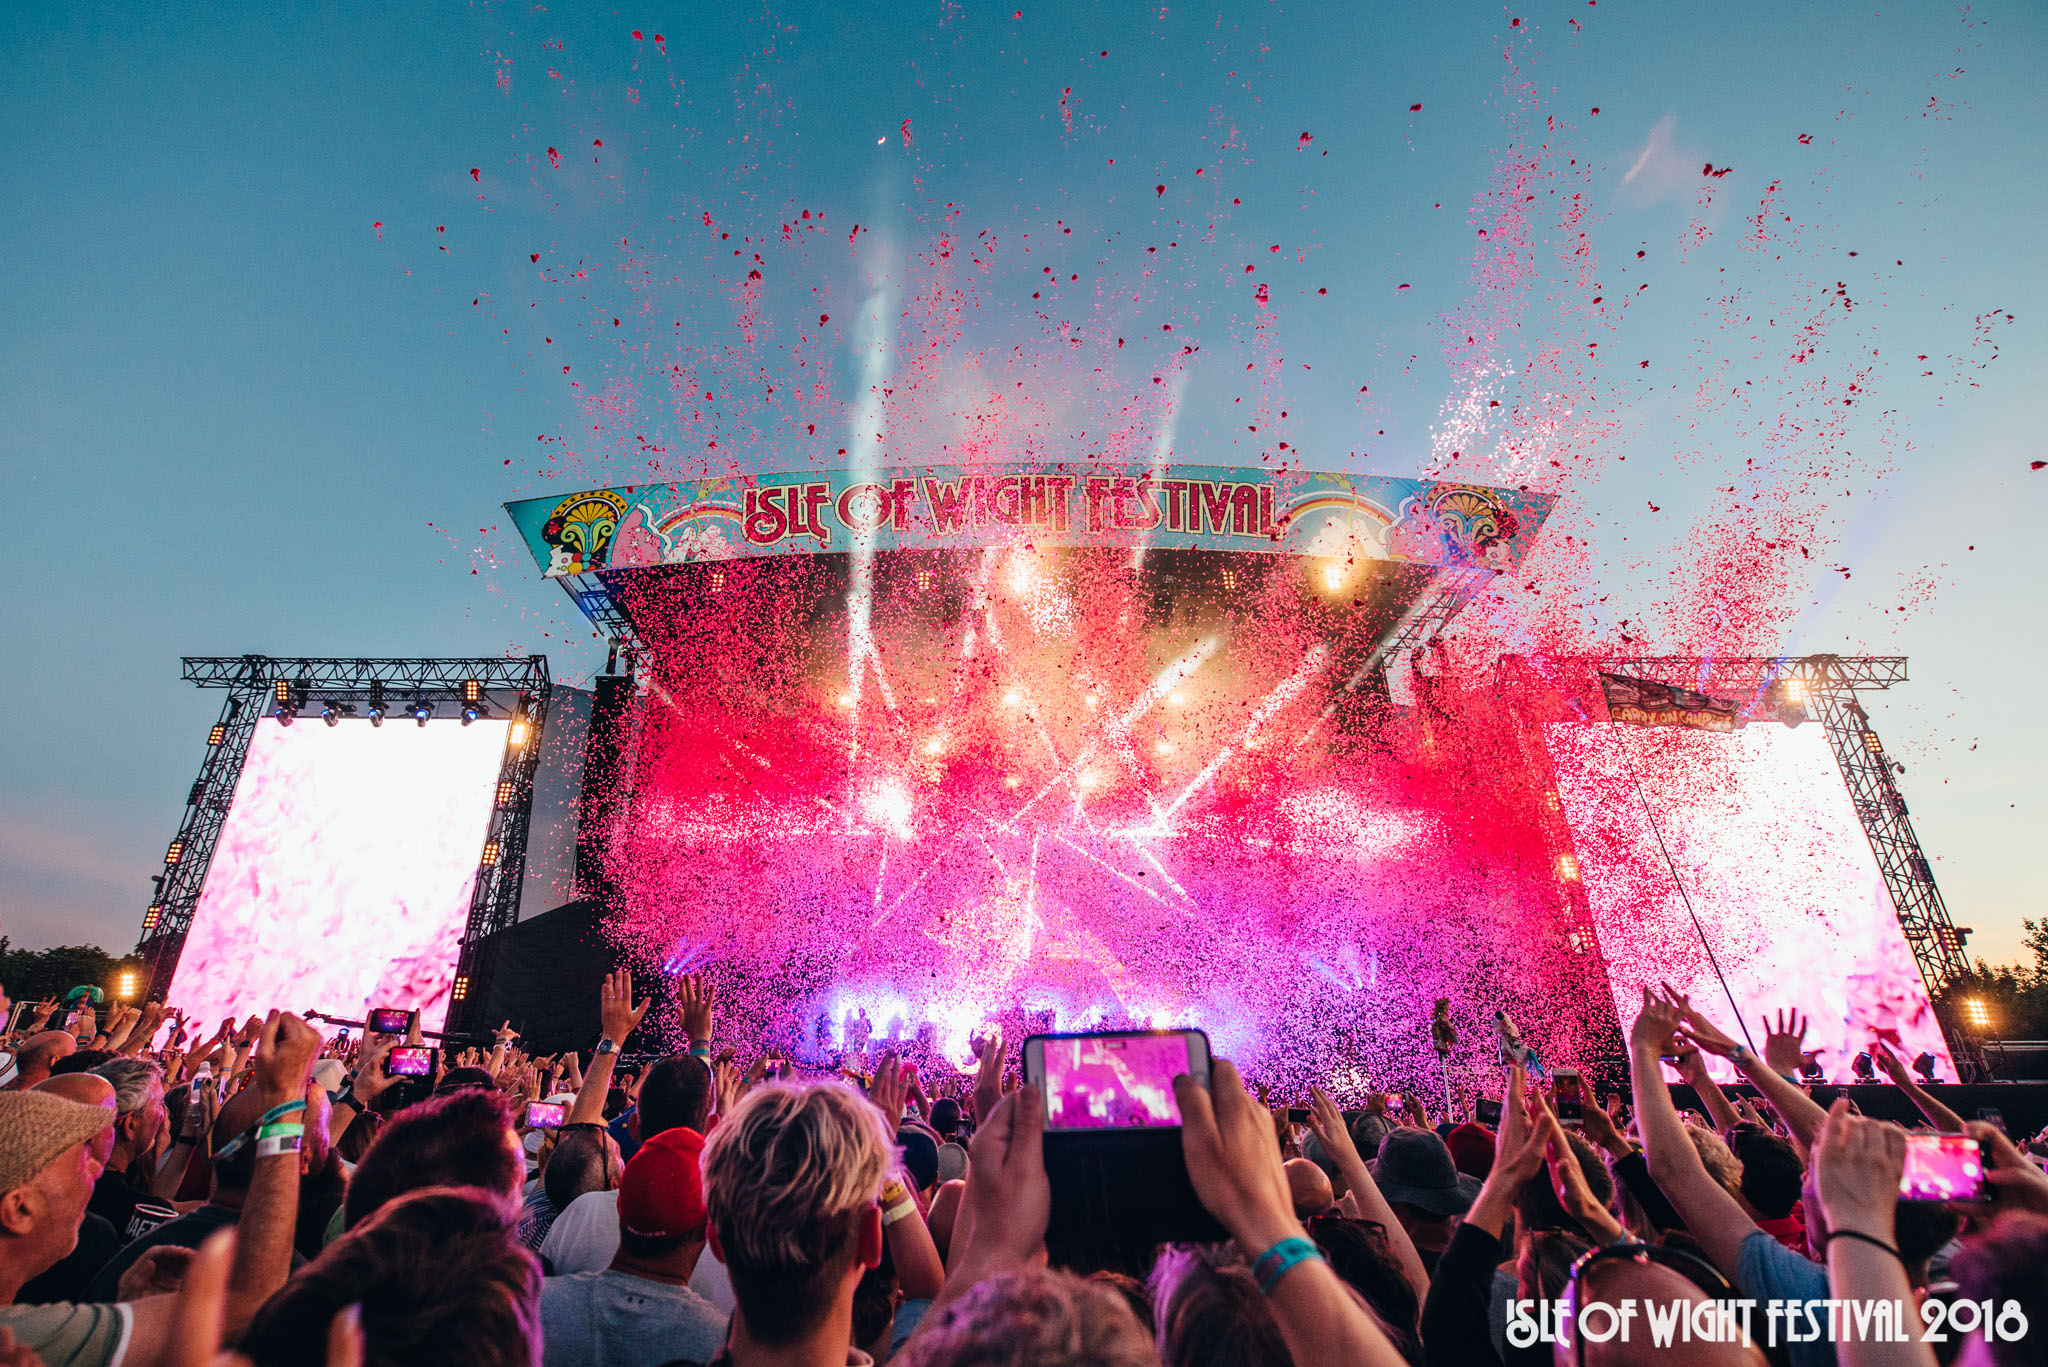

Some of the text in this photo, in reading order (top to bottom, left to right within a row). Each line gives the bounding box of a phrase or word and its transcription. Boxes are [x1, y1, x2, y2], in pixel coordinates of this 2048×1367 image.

[741, 474, 1284, 546] ISLE OF WIGHT FESTIVAL
[1611, 707, 1657, 725] CARRY
[1660, 710, 1678, 723] ON
